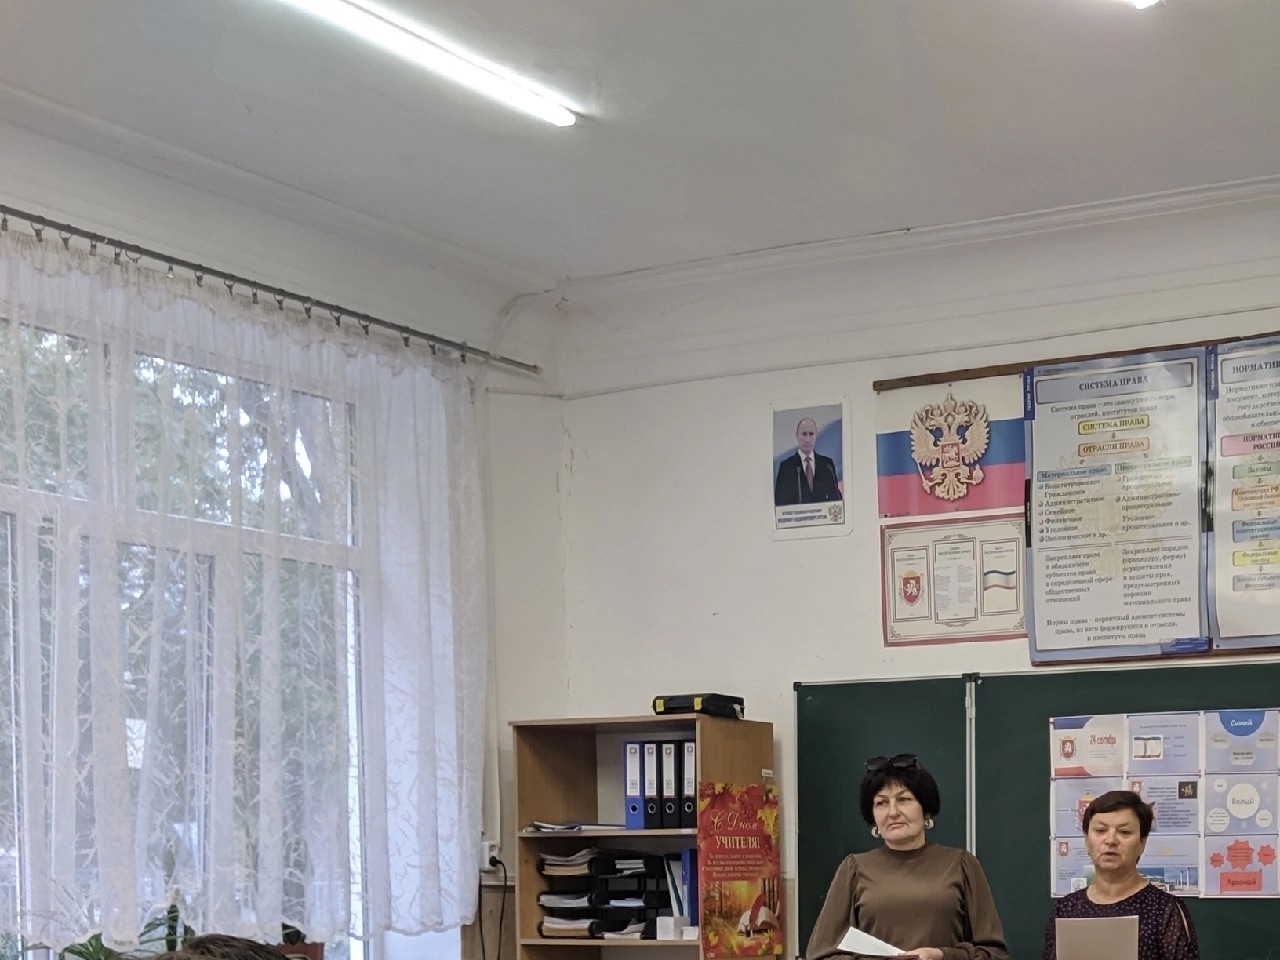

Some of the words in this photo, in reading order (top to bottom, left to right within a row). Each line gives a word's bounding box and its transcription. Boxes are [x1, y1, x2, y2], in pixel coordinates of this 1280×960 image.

[1079, 379, 1118, 391] СИСТЕМА
[1089, 734, 1097, 745] 24
[1231, 797, 1254, 805] Белый
[711, 809, 726, 833] С
[727, 811, 759, 831] Днем
[714, 835, 761, 850] УЧИТЕЛЯ!
[1226, 877, 1257, 888] Красный
